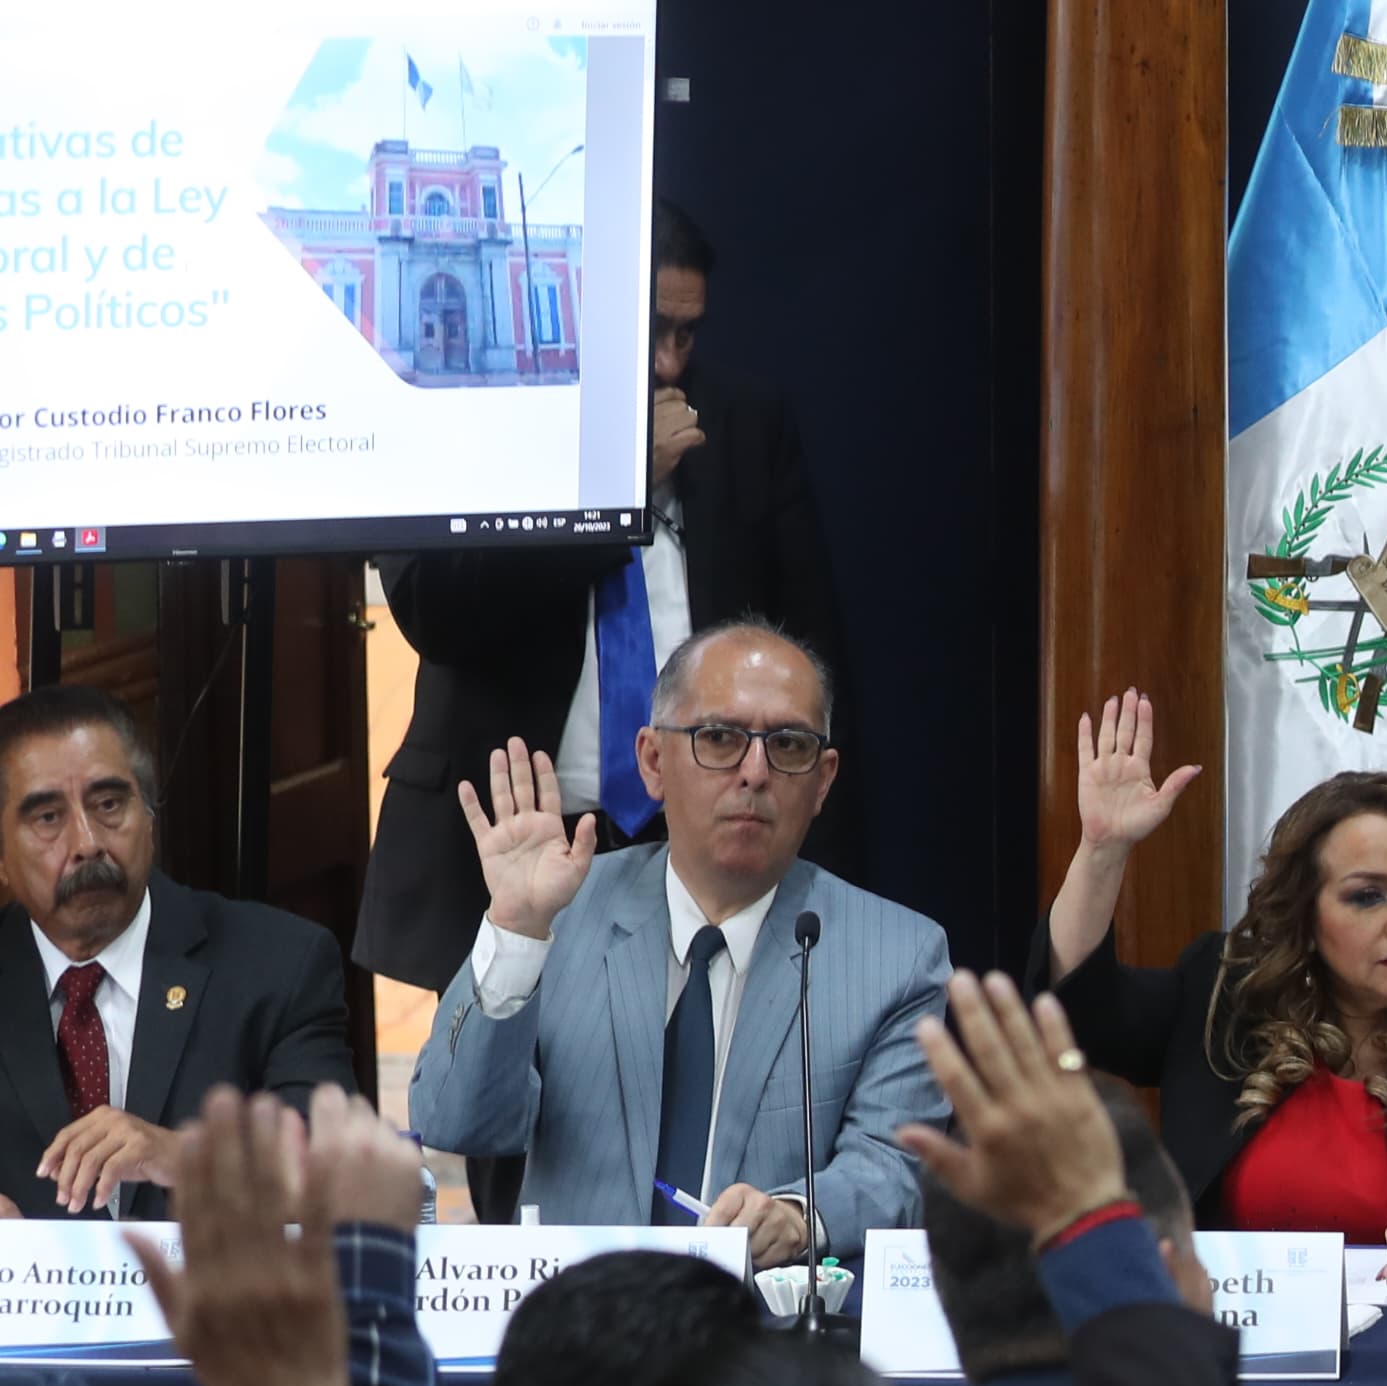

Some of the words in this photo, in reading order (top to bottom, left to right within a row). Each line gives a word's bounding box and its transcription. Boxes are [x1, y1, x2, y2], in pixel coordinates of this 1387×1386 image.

[131, 119, 184, 157] de
[57, 187, 83, 216] a
[99, 176, 136, 215] la
[153, 177, 228, 224] Ley
[84, 245, 108, 283] y
[123, 232, 175, 271] de
[34, 404, 147, 428] Custodio
[156, 403, 242, 424] Franco
[251, 400, 327, 422] Flores
[92, 438, 178, 460] Tribunal
[185, 437, 280, 462] Supremo
[288, 431, 375, 454] Electoral
[23, 1261, 148, 1286] Antonio
[415, 1257, 518, 1281] Alvaro
[889, 1276, 930, 1288] 2023
